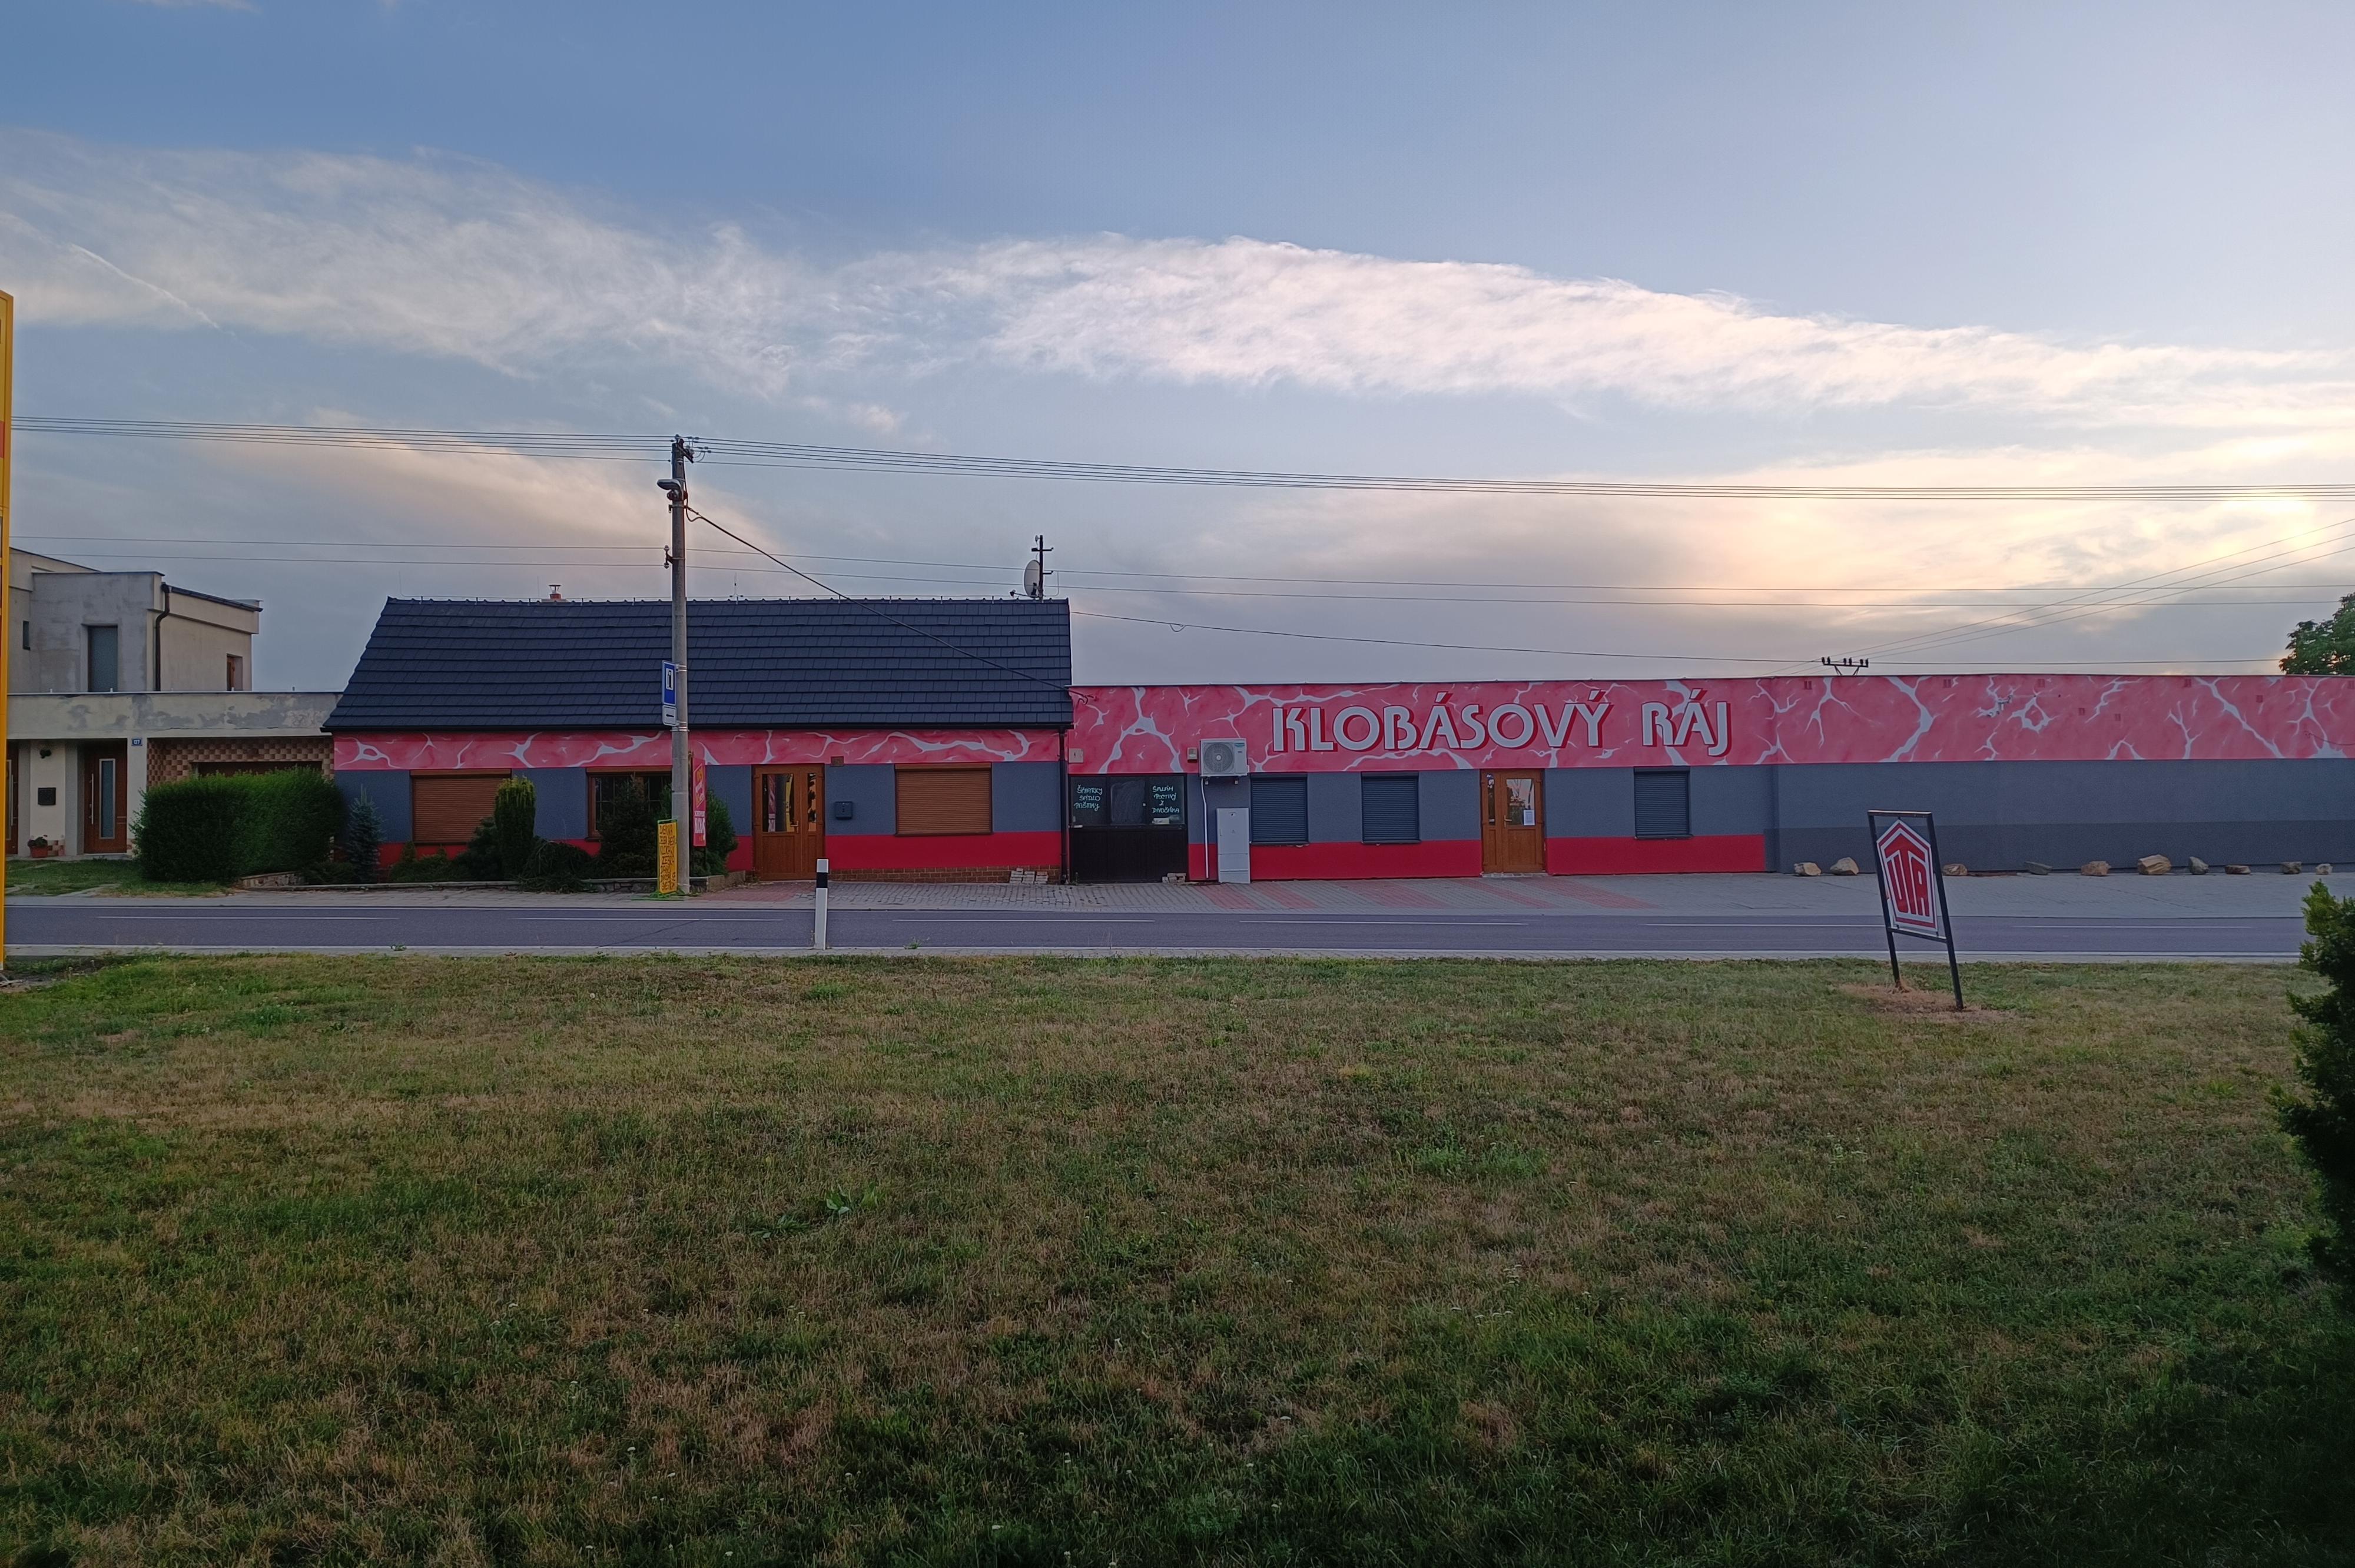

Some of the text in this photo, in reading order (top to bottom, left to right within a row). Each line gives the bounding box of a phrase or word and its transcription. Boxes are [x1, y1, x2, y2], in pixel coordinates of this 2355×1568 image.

[1272, 688, 1732, 758] KLOBÁSOVÝ RÁJ
[1884, 833, 1931, 917] UTA
